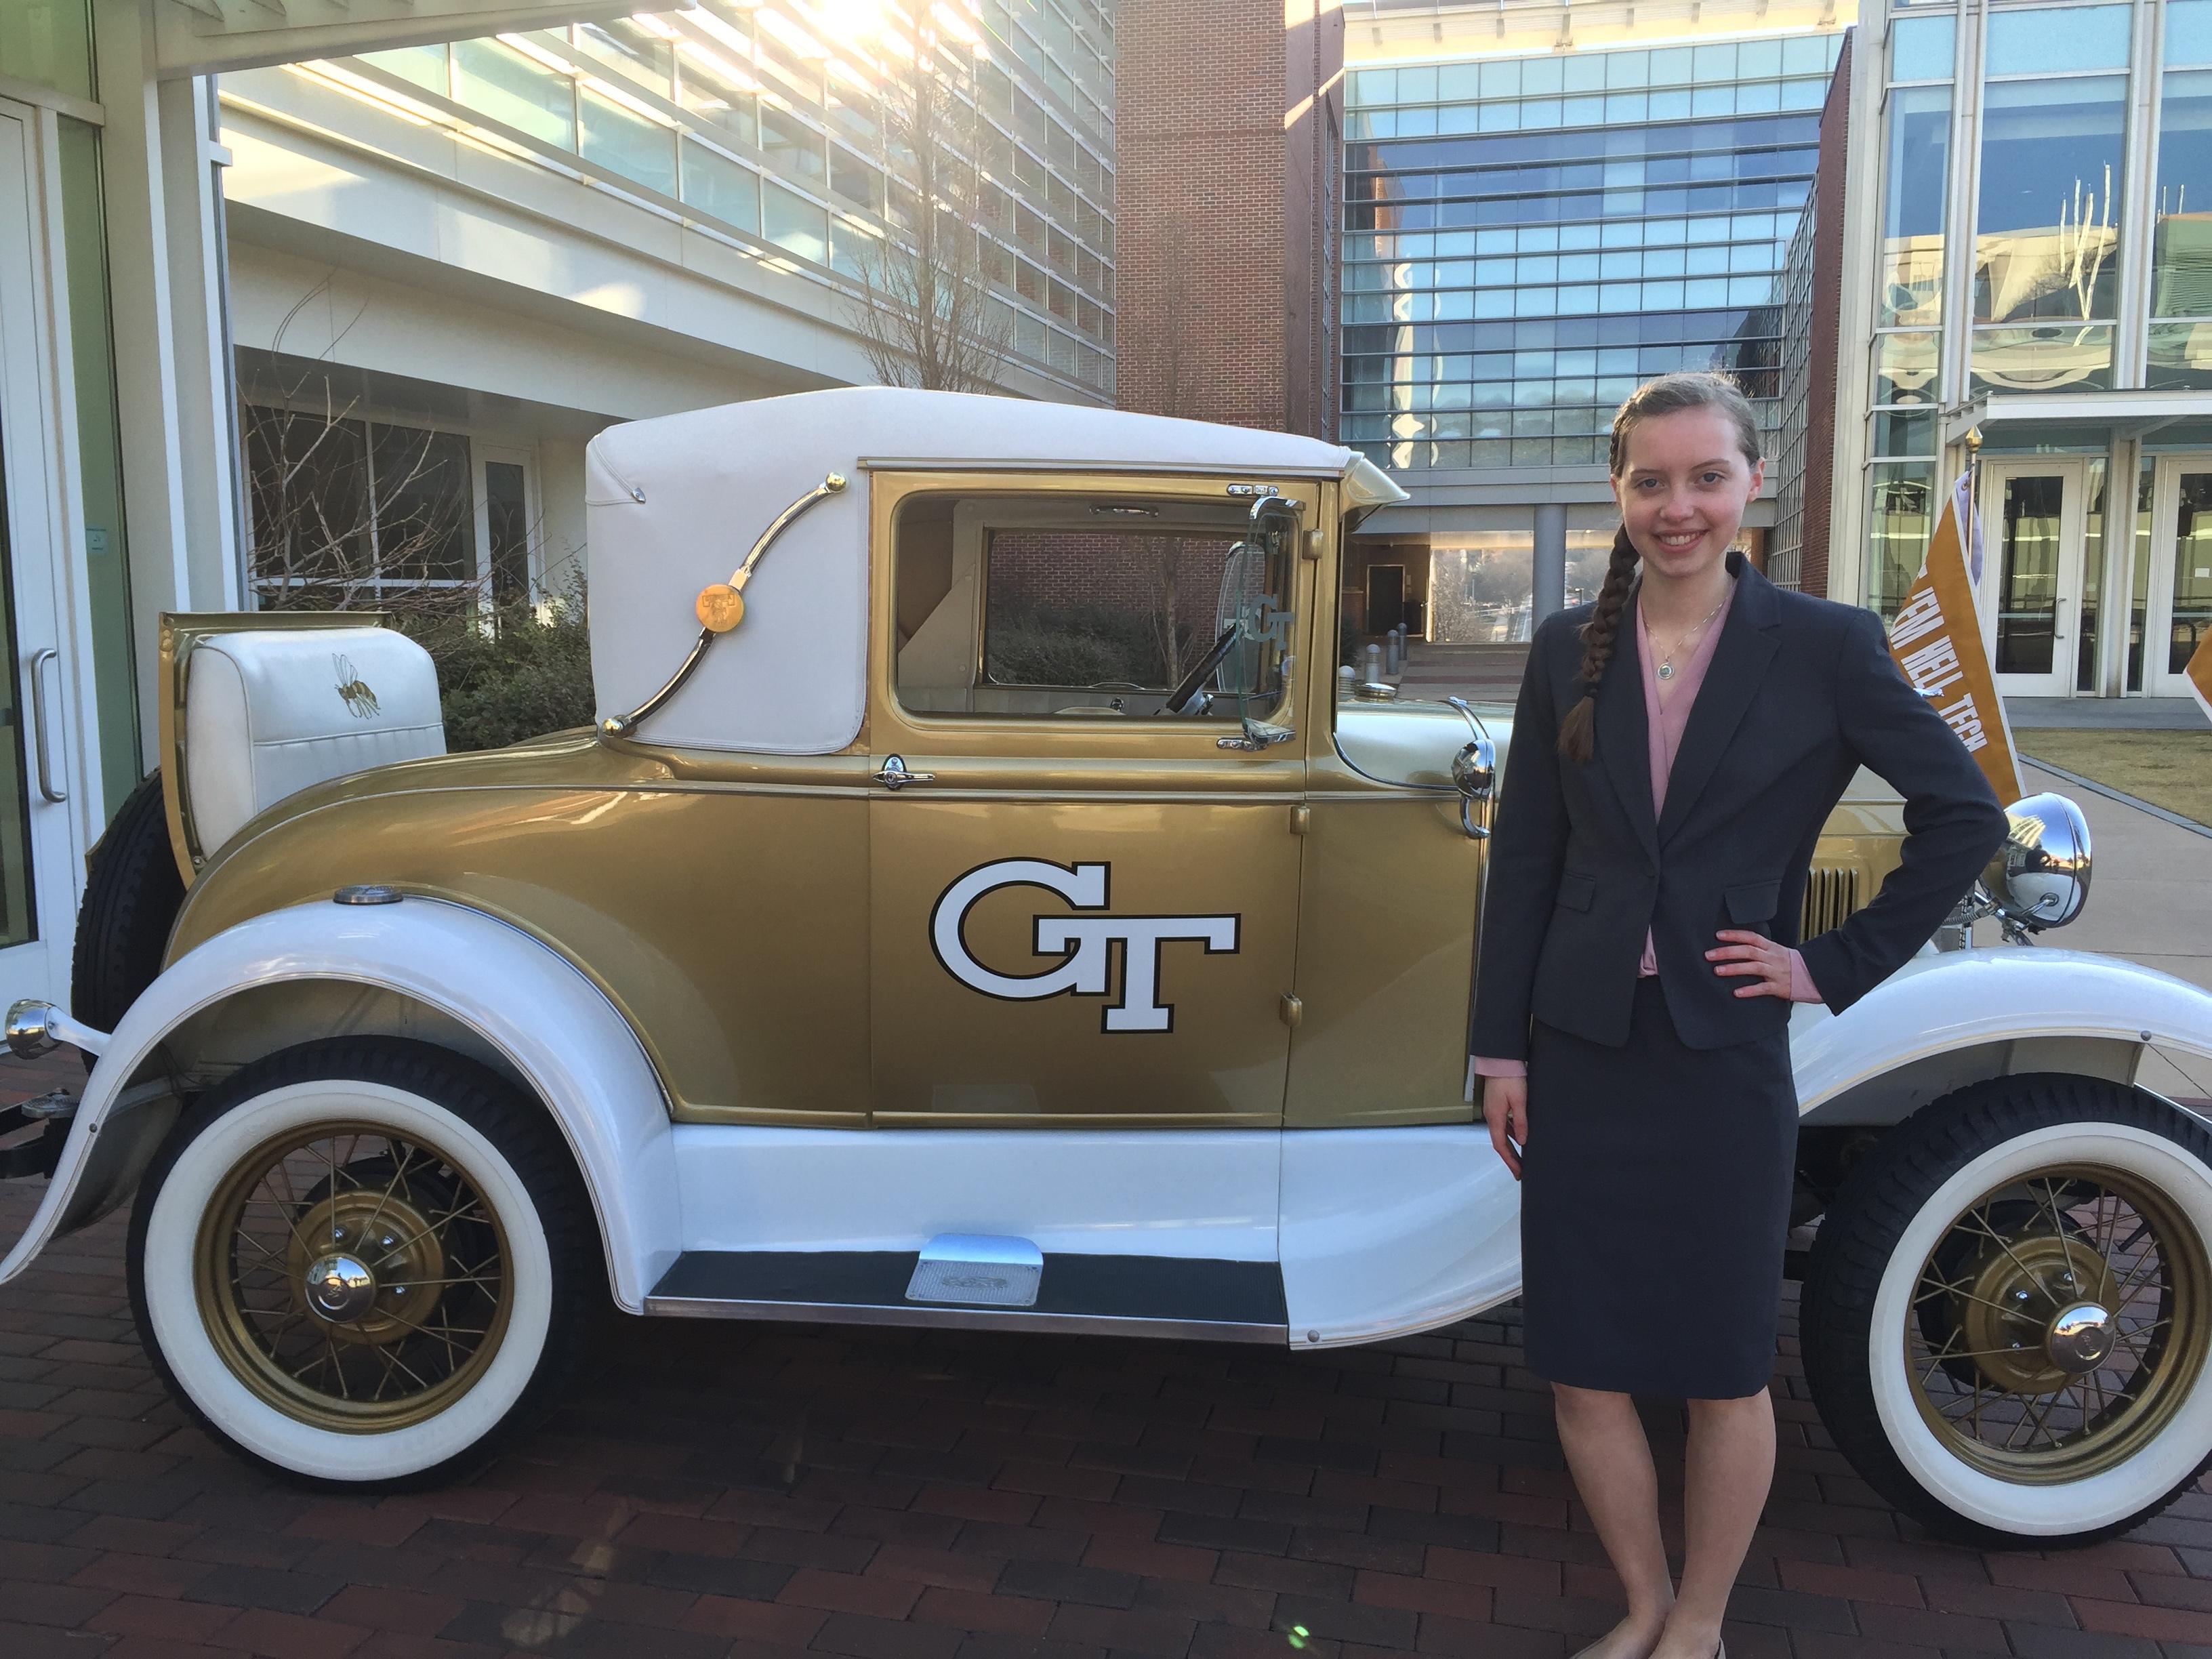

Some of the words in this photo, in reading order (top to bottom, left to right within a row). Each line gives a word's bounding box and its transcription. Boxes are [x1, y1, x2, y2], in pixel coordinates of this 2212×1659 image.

[1248, 593, 1294, 651] GT
[1900, 635, 1964, 689] HELL
[928, 857, 1241, 1033] GT
